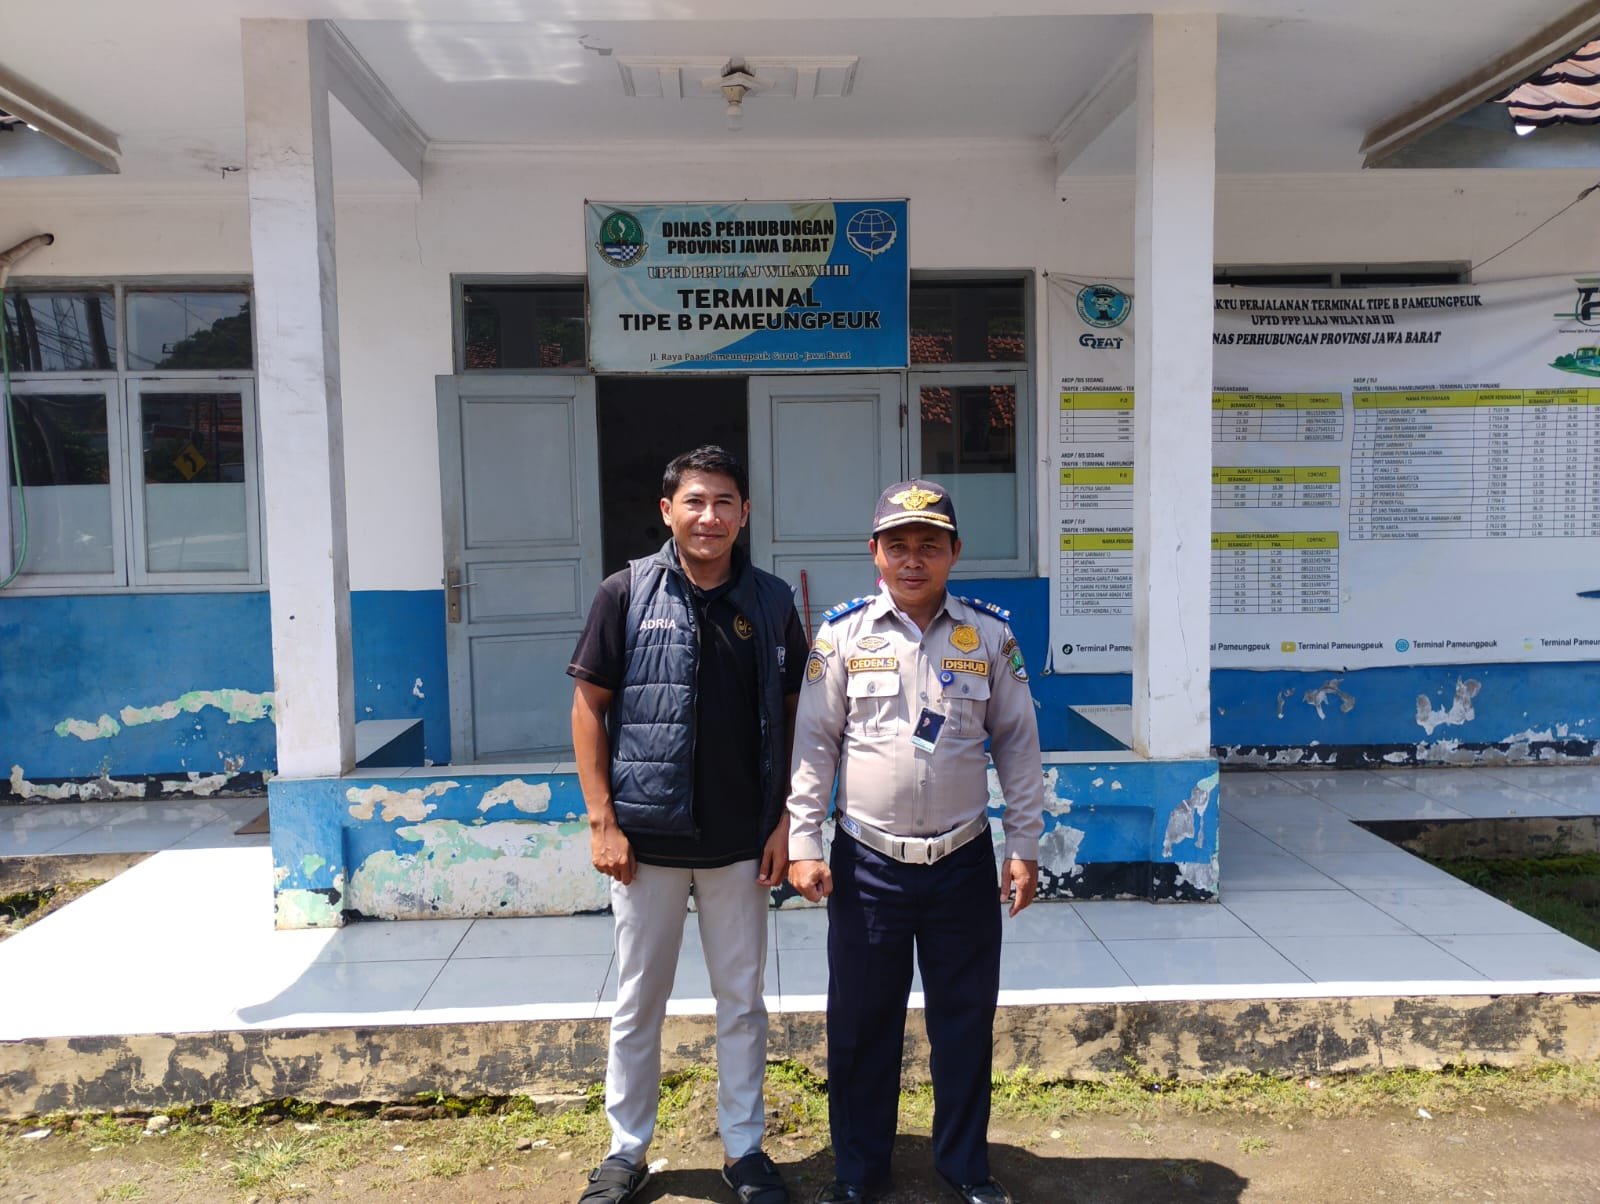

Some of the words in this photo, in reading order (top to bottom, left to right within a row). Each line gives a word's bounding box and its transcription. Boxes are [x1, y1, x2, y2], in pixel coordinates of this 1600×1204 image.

[662, 221, 712, 239] DINAS
[715, 219, 834, 237] PERHUBUNGAN
[667, 240, 736, 255] PROVINSI
[740, 239, 779, 254] JAWA
[782, 238, 829, 253] BARAT
[647, 266, 691, 279] UPTD
[692, 265, 721, 279] PPP
[723, 265, 762, 279] LLAJ
[761, 264, 830, 279] WILAYAH
[832, 264, 849, 276] III
[677, 287, 821, 309] TERMINAL
[1214, 299, 1237, 310] KTU
[1239, 299, 1309, 311] PERJALANAN
[1311, 298, 1365, 310] TERMINAL
[1367, 297, 1391, 309] TIPE
[1392, 297, 1400, 309] B
[1401, 296, 1482, 309] PAMEUNGPEUK
[619, 313, 671, 331] TIPE
[678, 313, 692, 331] B
[698, 311, 880, 331] PAMEUNGPEUK
[1251, 315, 1280, 326] UPTD
[1281, 315, 1303, 326] PPP
[1304, 314, 1329, 326] LLAJ
[1331, 314, 1380, 325] WILAYAH
[1382, 313, 1394, 324] III
[1212, 333, 1234, 345] NAS
[1236, 332, 1318, 345] PERHUBUNGAN
[1319, 332, 1370, 344] PROVINSI
[1371, 331, 1403, 343] JAWA
[1405, 331, 1441, 343] BARAT
[661, 353, 682, 362] Raya
[685, 353, 705, 361] Paas
[706, 351, 770, 363] Pameungpeuk
[639, 618, 678, 631] ADRIA
[1076, 644, 1107, 652] Terminal
[1218, 642, 1270, 652] Pameungpeuk
[1298, 642, 1329, 650] Terminal
[1331, 641, 1384, 651] Pameungpeuk
[1413, 640, 1444, 649] Terminal
[1446, 640, 1498, 650] Pameungpeuk
[1540, 638, 1571, 647] Terminal
[945, 660, 985, 672] DISHUB
